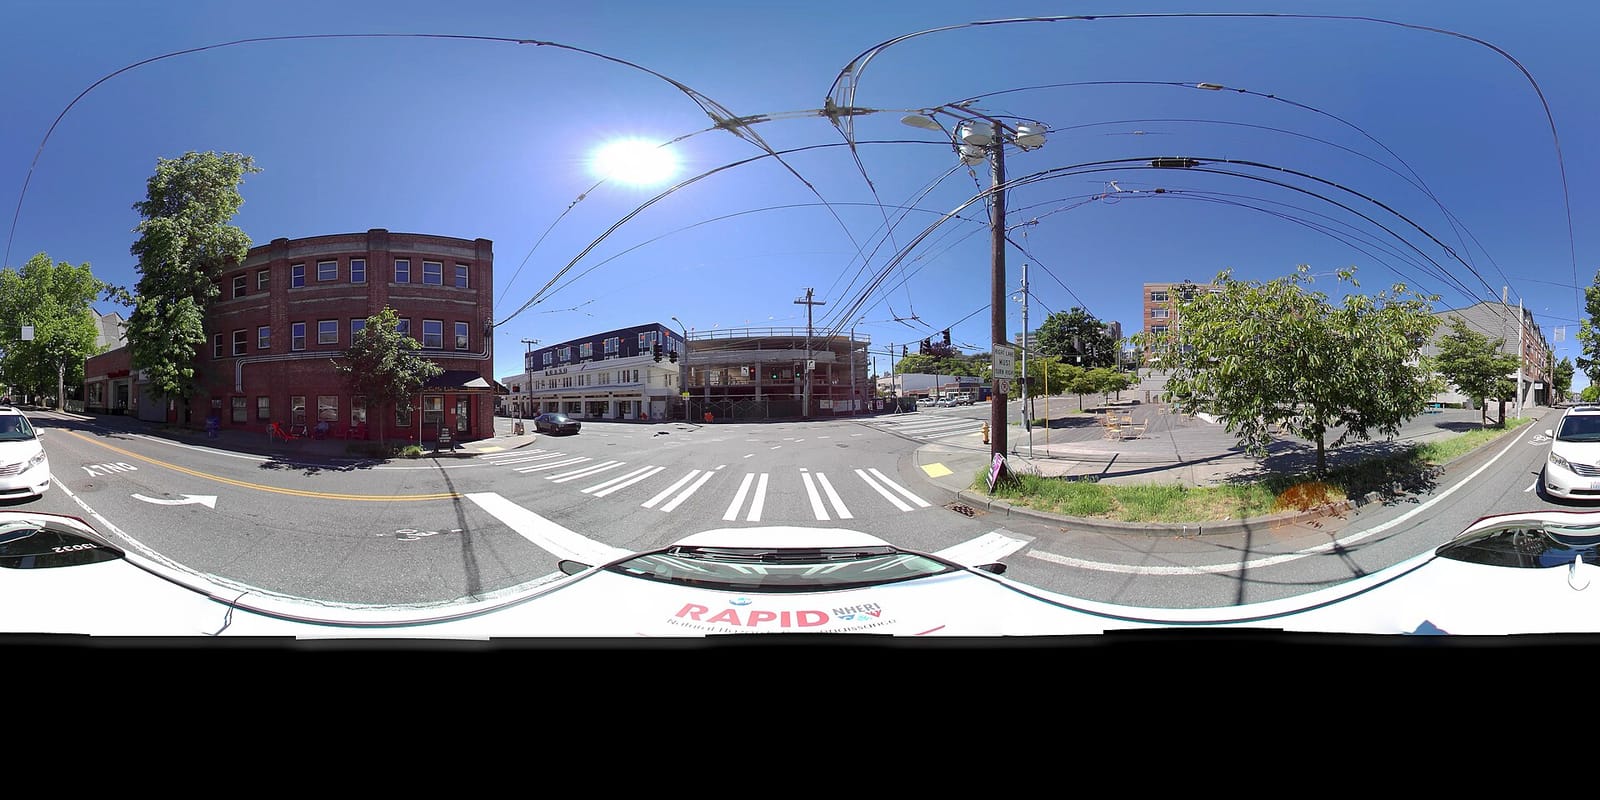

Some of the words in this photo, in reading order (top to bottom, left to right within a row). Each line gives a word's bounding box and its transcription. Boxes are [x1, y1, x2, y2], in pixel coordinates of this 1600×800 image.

[81, 462, 138, 477] ONLY
[51, 543, 97, 553] 13032
[675, 603, 830, 628] RAPID
[832, 602, 881, 616] NHERI
